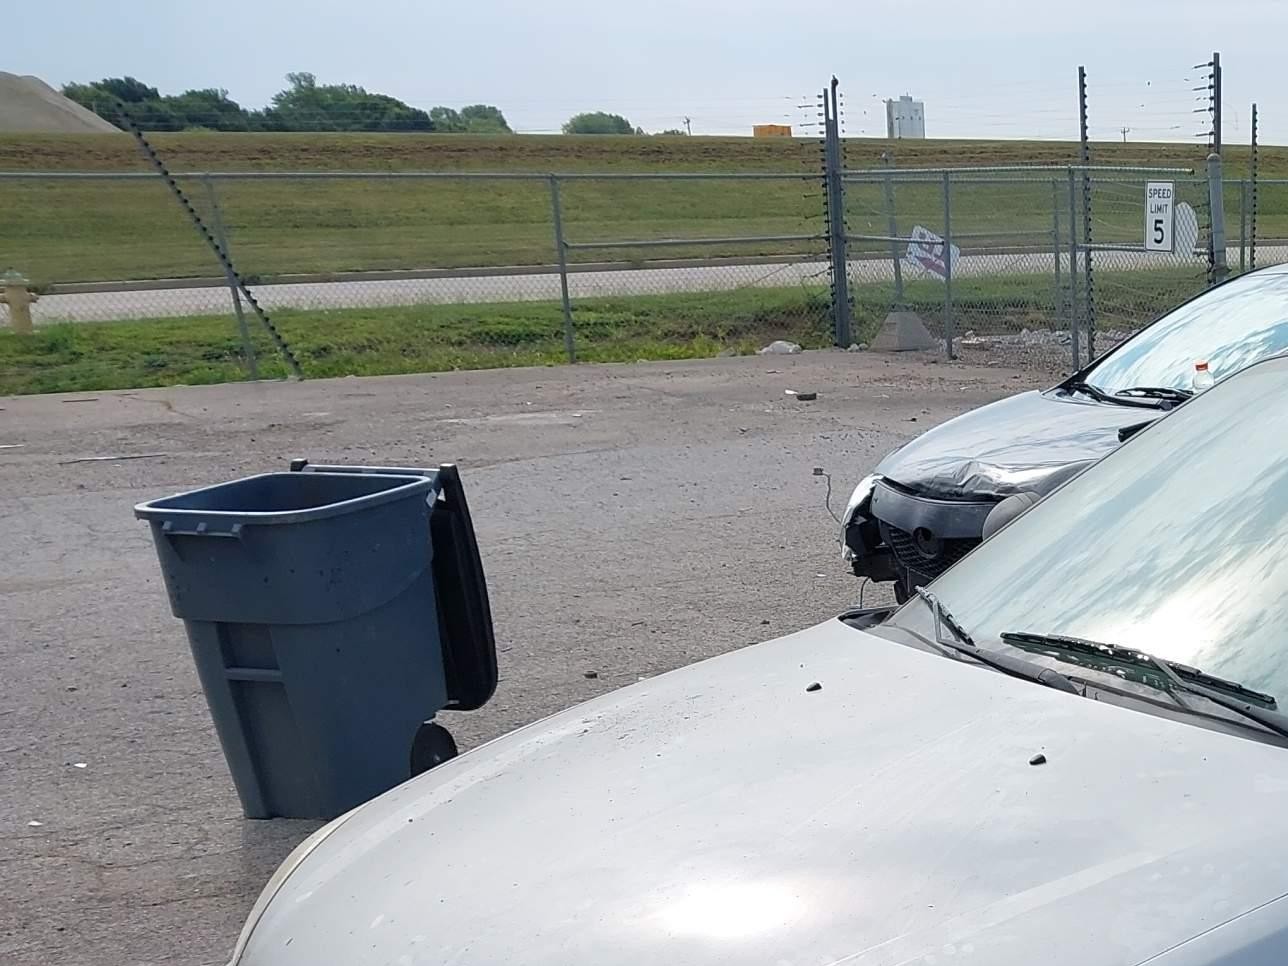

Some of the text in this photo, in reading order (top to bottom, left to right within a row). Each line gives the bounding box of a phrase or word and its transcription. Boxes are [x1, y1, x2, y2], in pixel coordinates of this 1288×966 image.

[1149, 188, 1171, 198] SPEED
[1150, 204, 1168, 214] LIMIT
[1154, 219, 1164, 244] 5
